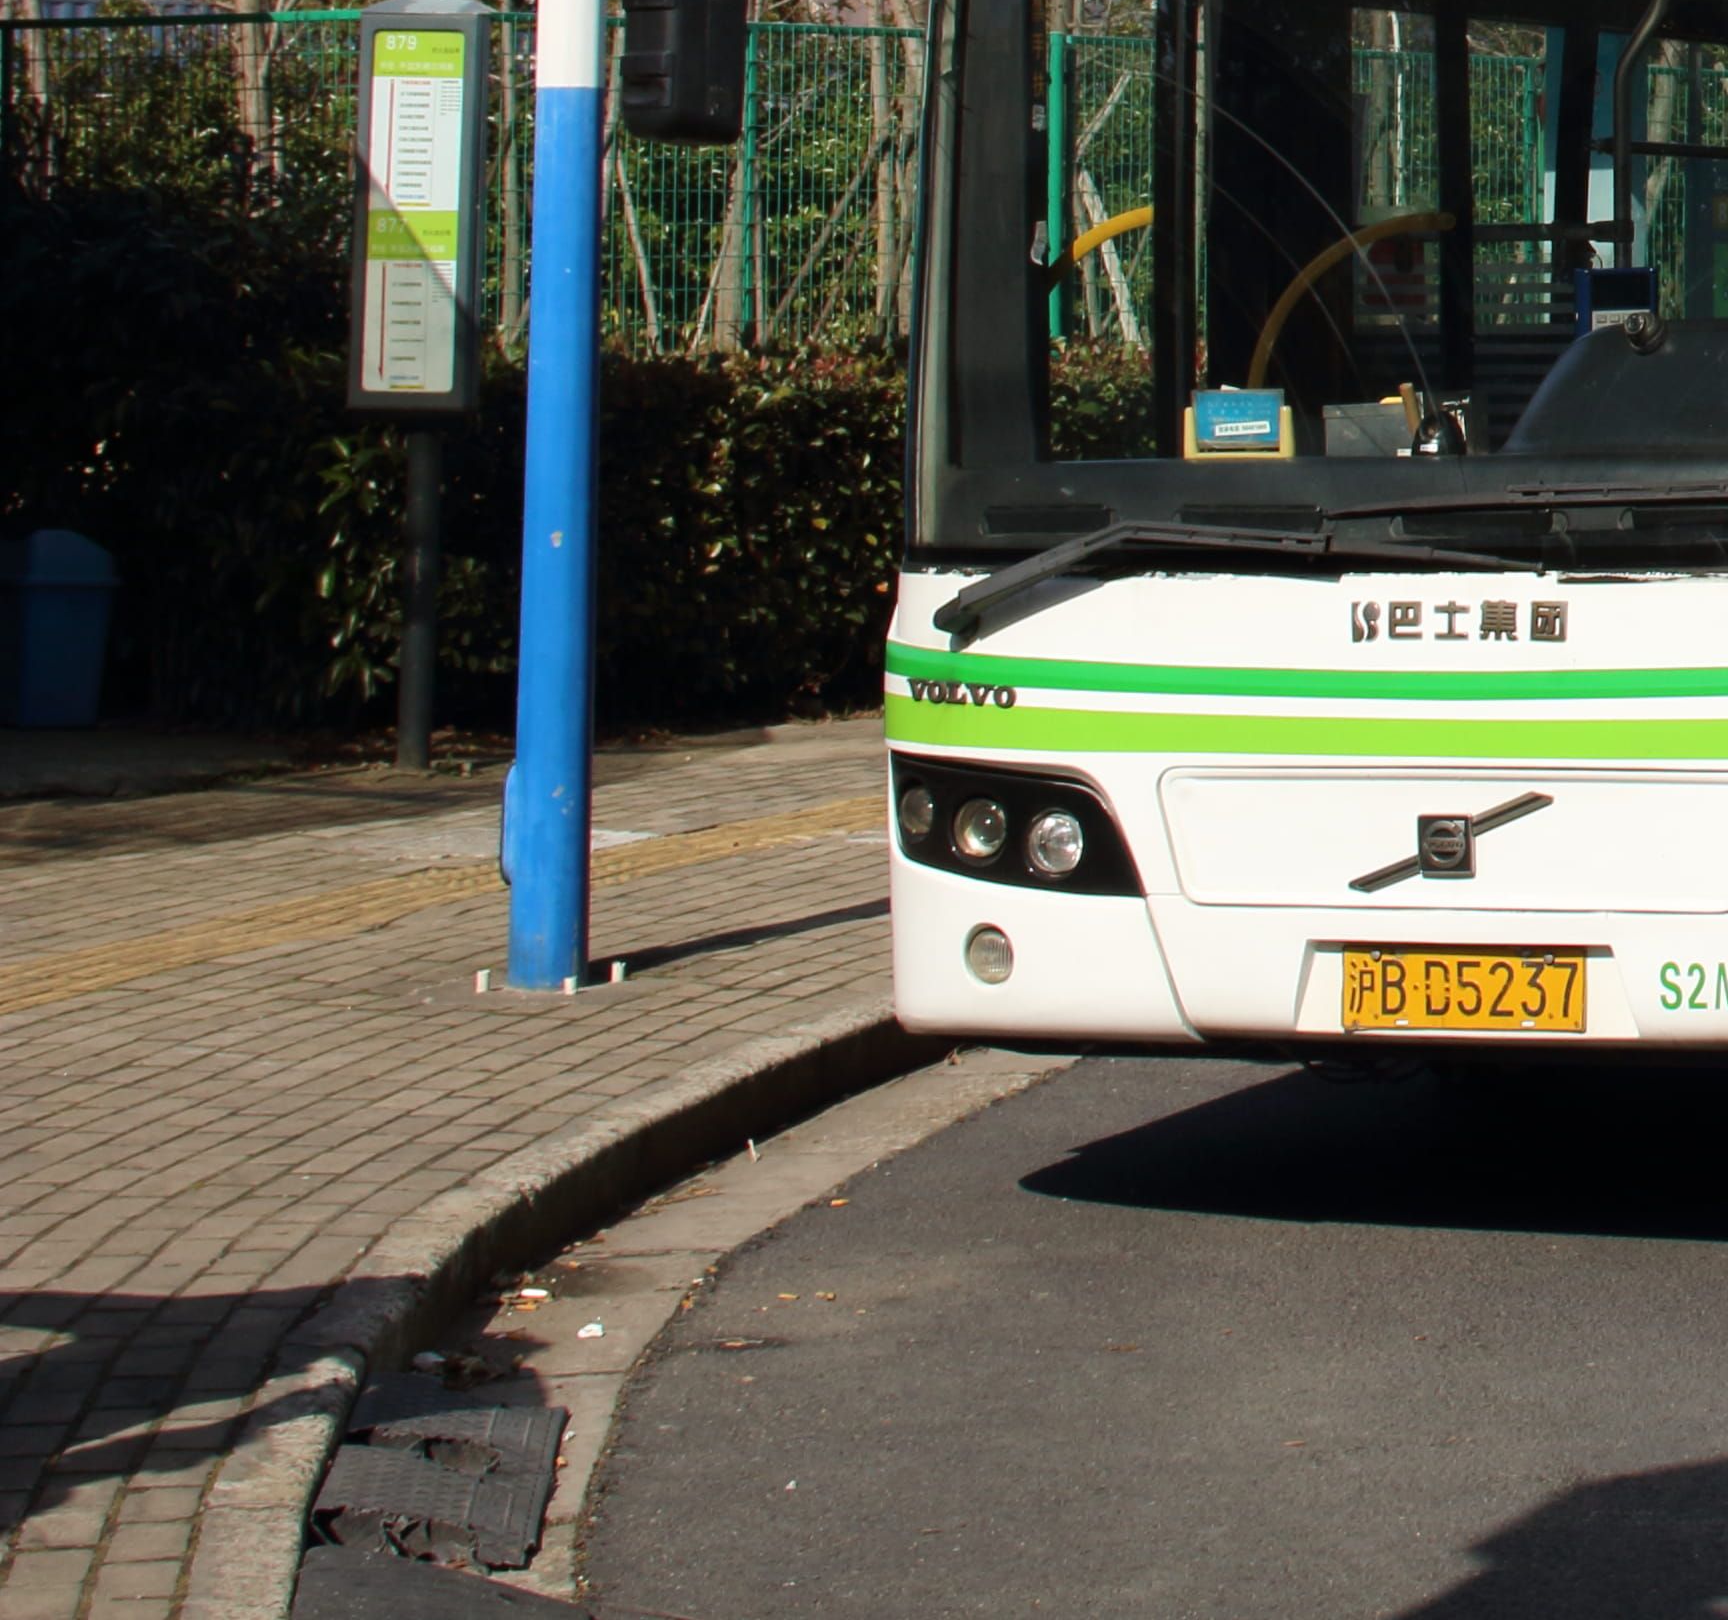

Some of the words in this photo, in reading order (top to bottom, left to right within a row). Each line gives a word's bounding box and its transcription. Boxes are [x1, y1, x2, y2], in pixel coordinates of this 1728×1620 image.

[385, 34, 418, 51] 879
[1388, 600, 1569, 643] 巴士集团
[907, 678, 1017, 709] VOLVO
